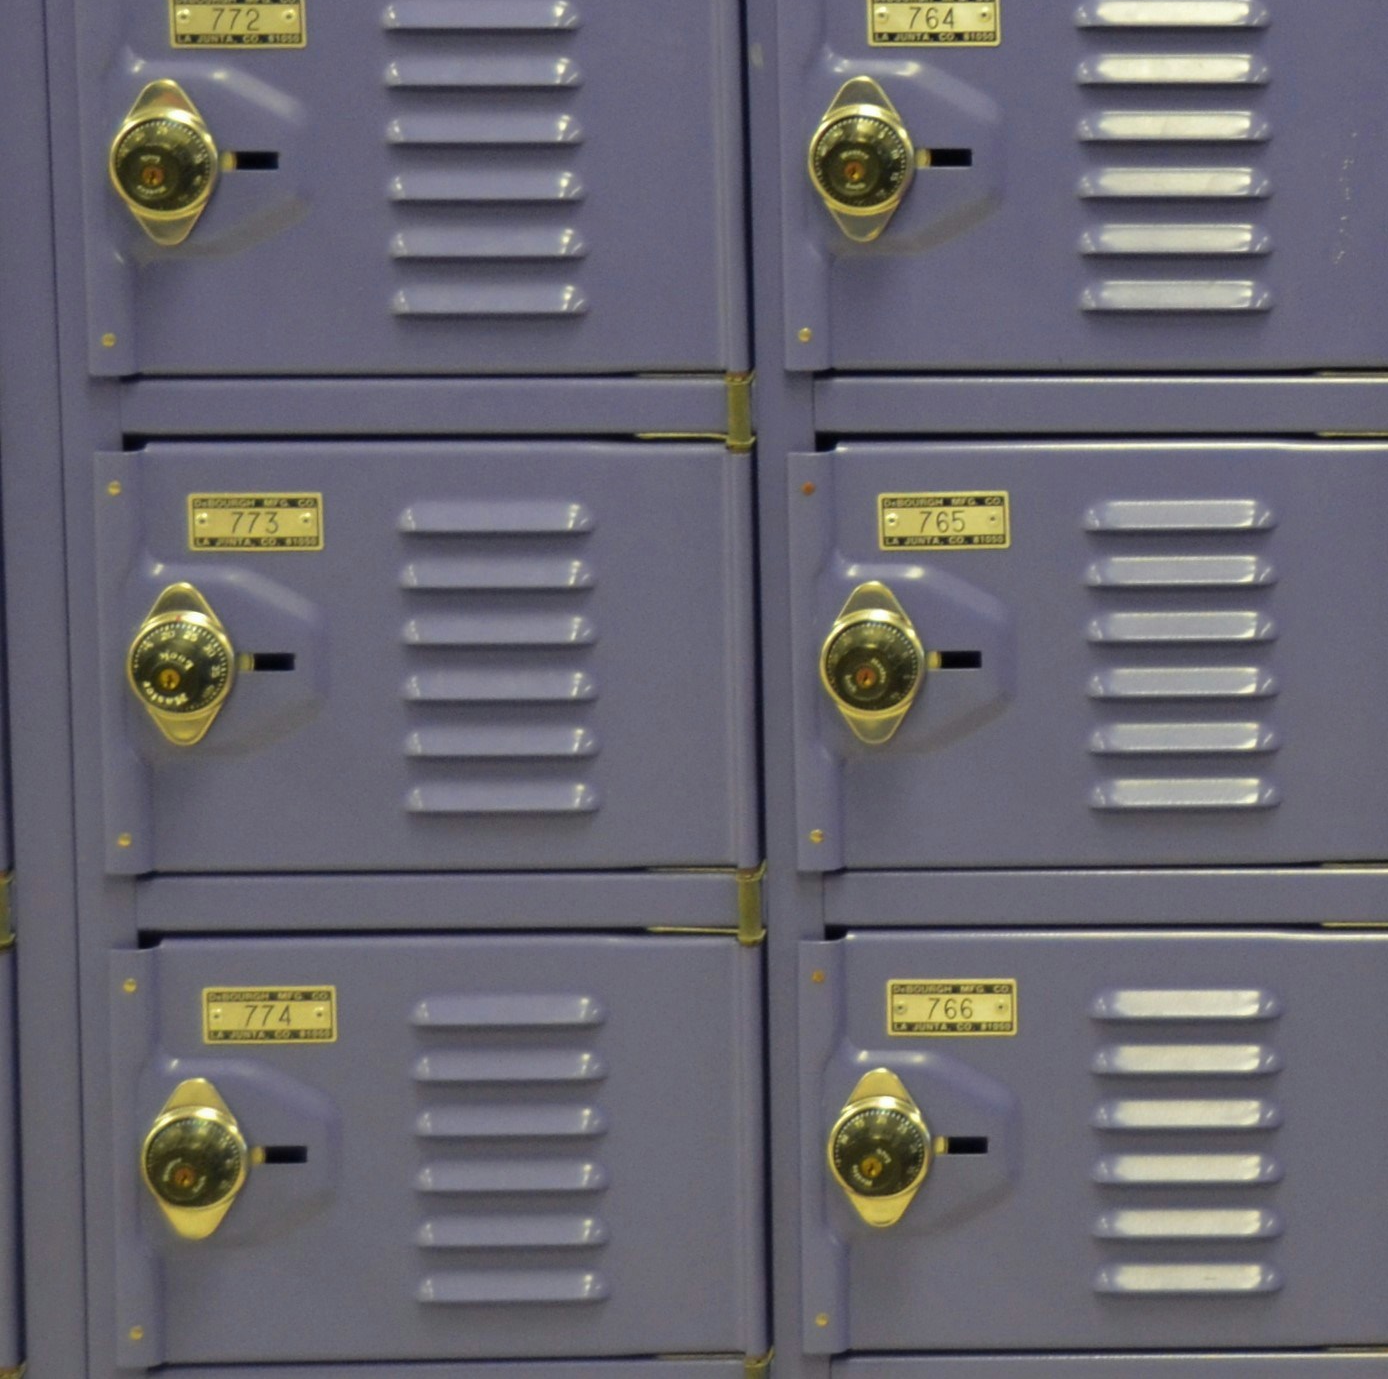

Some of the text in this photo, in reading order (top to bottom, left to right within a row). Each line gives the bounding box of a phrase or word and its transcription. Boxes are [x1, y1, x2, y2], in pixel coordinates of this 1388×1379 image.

[211, 7, 260, 31] 772
[908, 5, 956, 30] 764
[229, 511, 278, 535] 773
[918, 509, 966, 534] 765
[244, 1004, 292, 1028] 774
[927, 997, 974, 1020] 766
